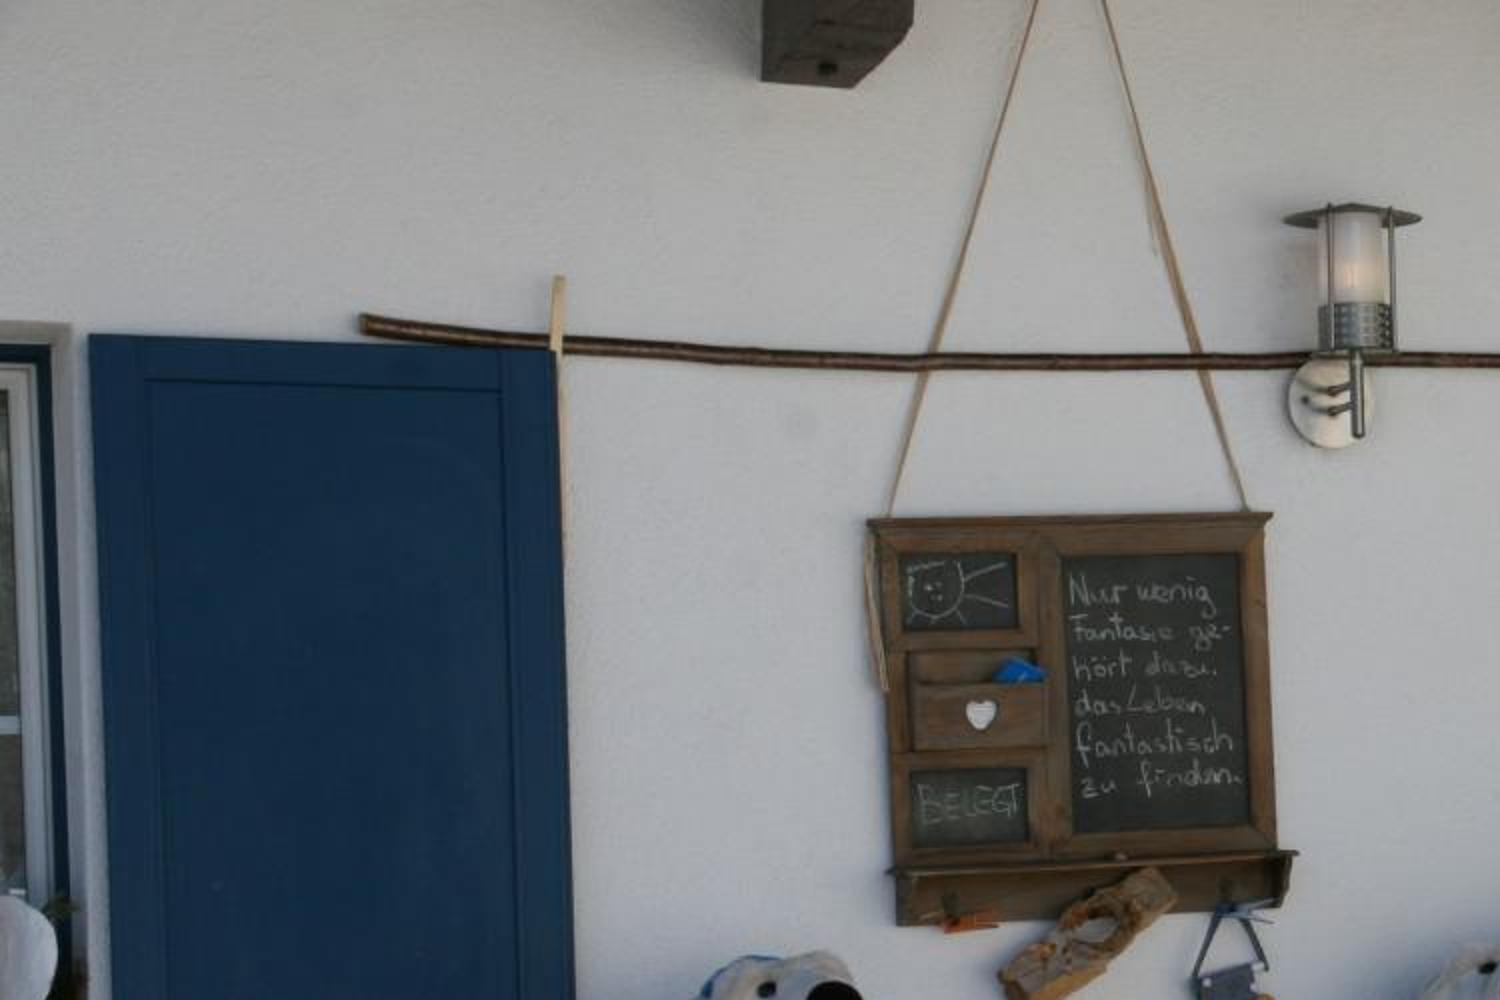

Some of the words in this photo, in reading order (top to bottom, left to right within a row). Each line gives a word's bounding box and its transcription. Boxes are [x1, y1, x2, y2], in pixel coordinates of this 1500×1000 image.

[1068, 571, 1128, 606] Nur
[1136, 575, 1217, 620] wenig
[1071, 648, 1134, 682] hört
[1075, 687, 1121, 717] das
[1126, 684, 1206, 716] Leben
[1075, 711, 1234, 768] fantastisch
[1080, 777, 1118, 800] zu
